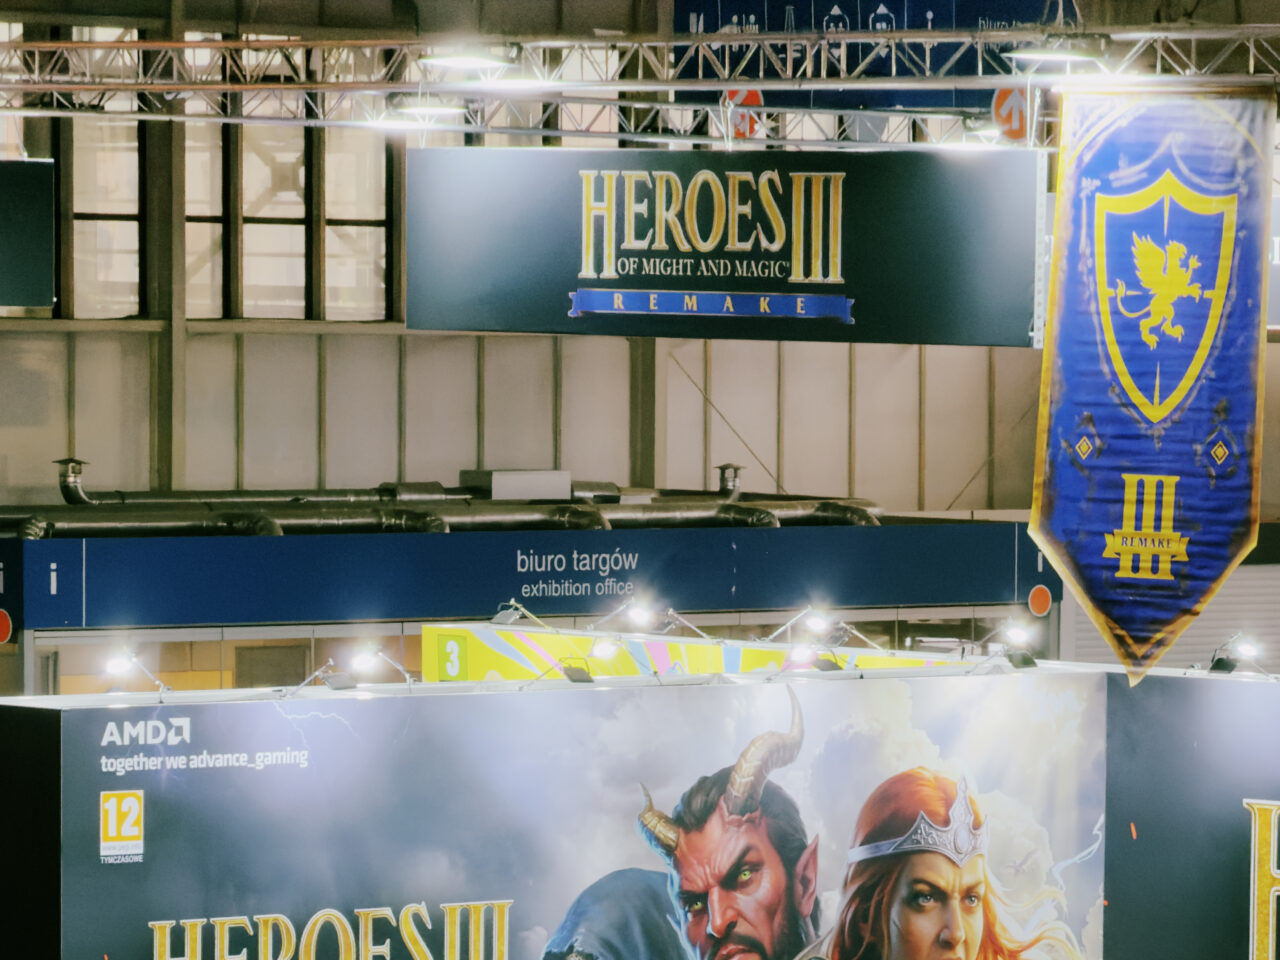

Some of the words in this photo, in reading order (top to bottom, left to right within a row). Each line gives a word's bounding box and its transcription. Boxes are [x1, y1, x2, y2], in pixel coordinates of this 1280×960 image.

[578, 169, 786, 279] HEROES
[788, 172, 846, 284] III
[617, 258, 636, 275] OF
[641, 258, 694, 276] MIGHT
[697, 259, 731, 277] AND
[613, 293, 806, 314] REMAKE
[1114, 473, 1181, 580] III
[1120, 536, 1172, 549] REMAKE
[516, 550, 567, 572] biuro
[572, 548, 639, 576] targów
[521, 580, 591, 597] exhibition
[595, 578, 634, 596] office
[445, 640, 460, 676] 3
[101, 720, 166, 746] AMD
[101, 753, 162, 776] together
[165, 755, 187, 770] we
[189, 748, 309, 770] advance_gaming
[103, 797, 140, 838] 12
